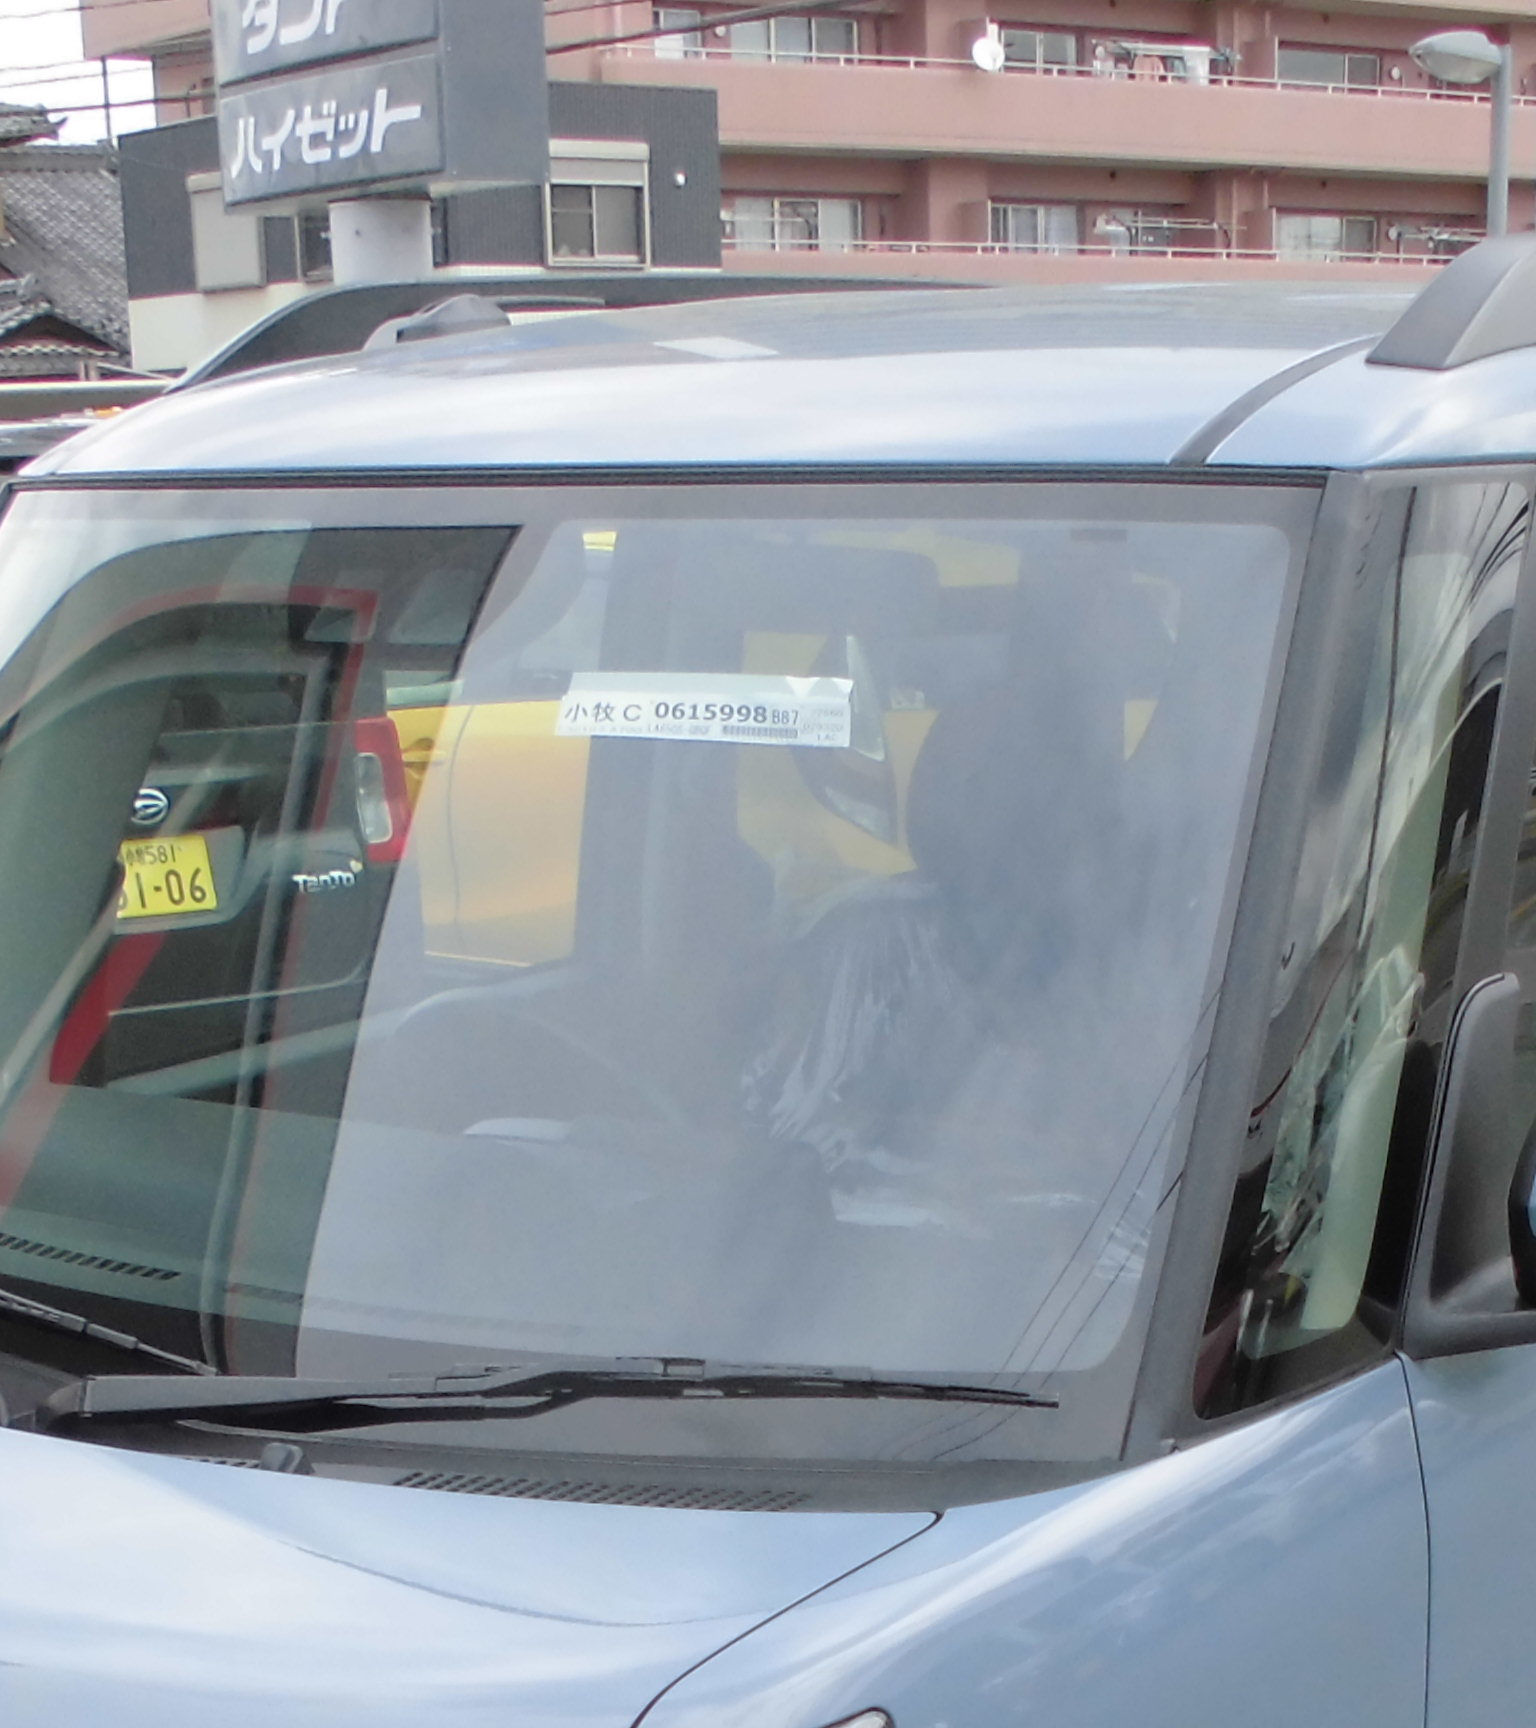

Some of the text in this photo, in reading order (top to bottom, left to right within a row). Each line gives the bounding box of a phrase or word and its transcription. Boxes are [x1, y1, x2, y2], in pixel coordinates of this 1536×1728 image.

[230, 88, 421, 179] ハイゼット
[655, 702, 767, 724] 0615998
[117, 867, 206, 909] 1-06
